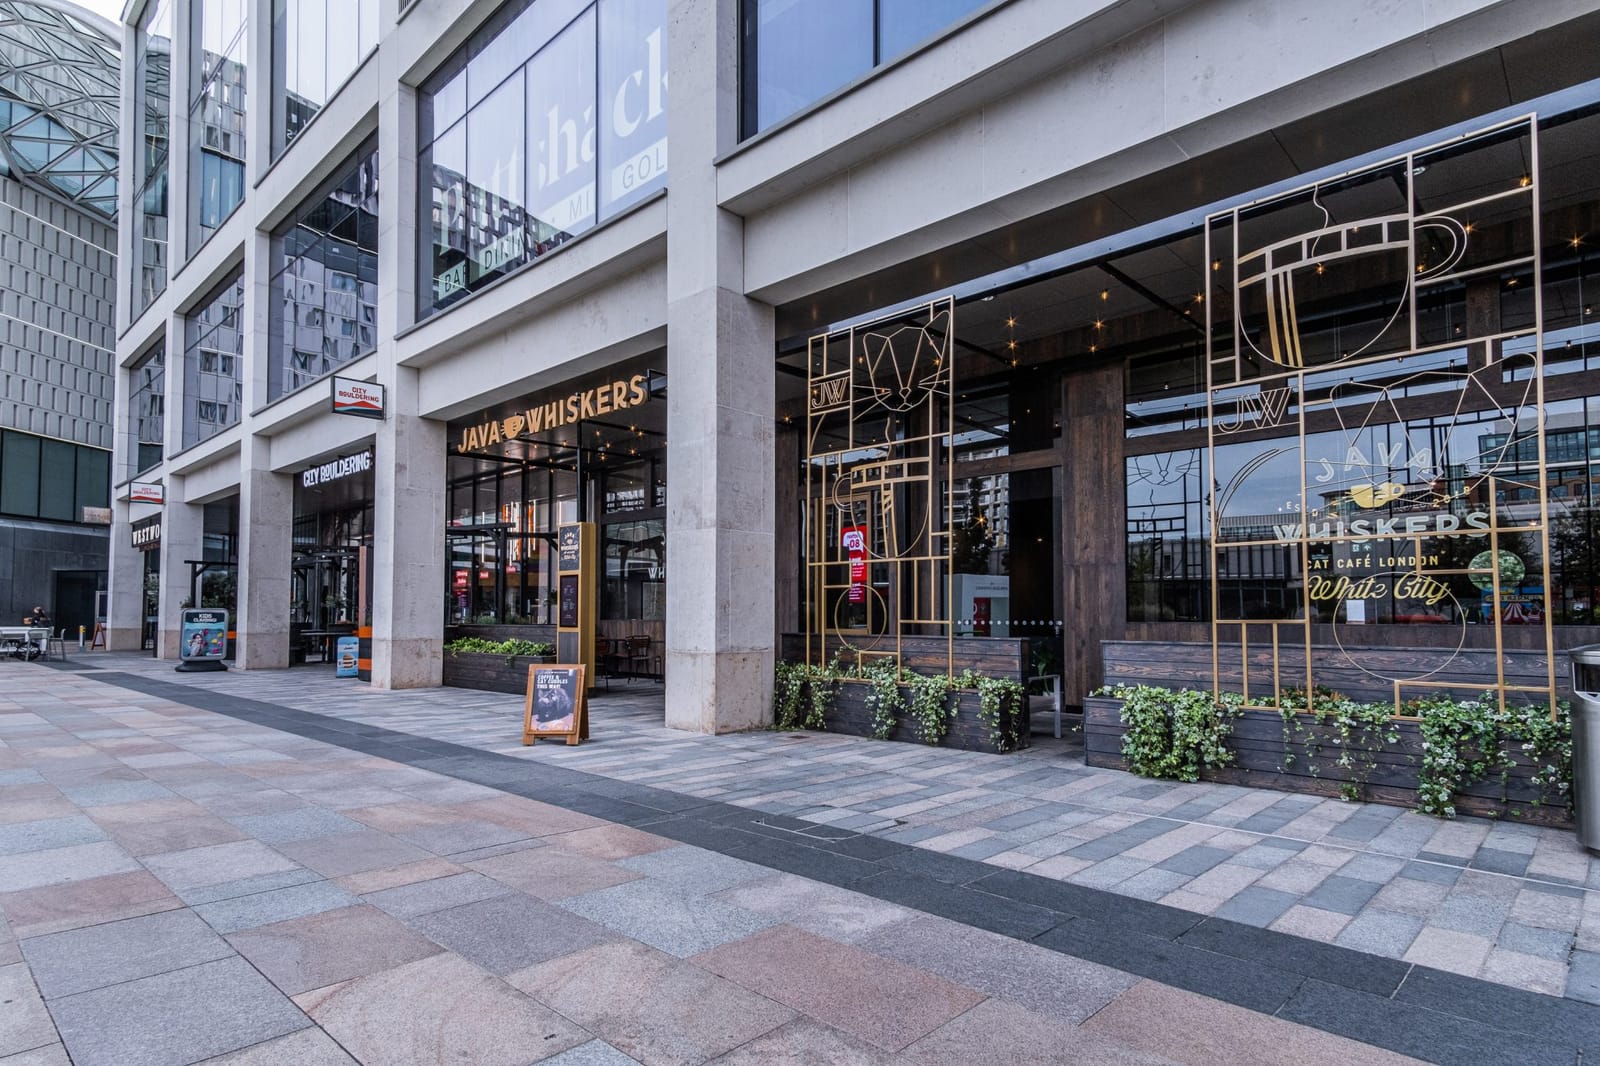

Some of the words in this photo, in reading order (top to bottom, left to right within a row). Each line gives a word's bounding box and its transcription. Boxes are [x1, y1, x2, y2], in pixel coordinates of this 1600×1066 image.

[338, 390, 380, 403] BOULDERING
[351, 386, 368, 394] CITY
[457, 420, 500, 453] JAVA
[525, 374, 647, 434] WHISKERS
[1217, 386, 1292, 435] JW
[303, 467, 320, 488] CITY
[320, 451, 370, 483] BOULDERING
[1315, 442, 1432, 482] JAVA
[1272, 511, 1490, 547] WHISKERS
[1336, 553, 1371, 568] CAFÉ
[1379, 555, 1439, 568] LONDON
[1308, 575, 1388, 601] White
[1393, 570, 1452, 606] City
